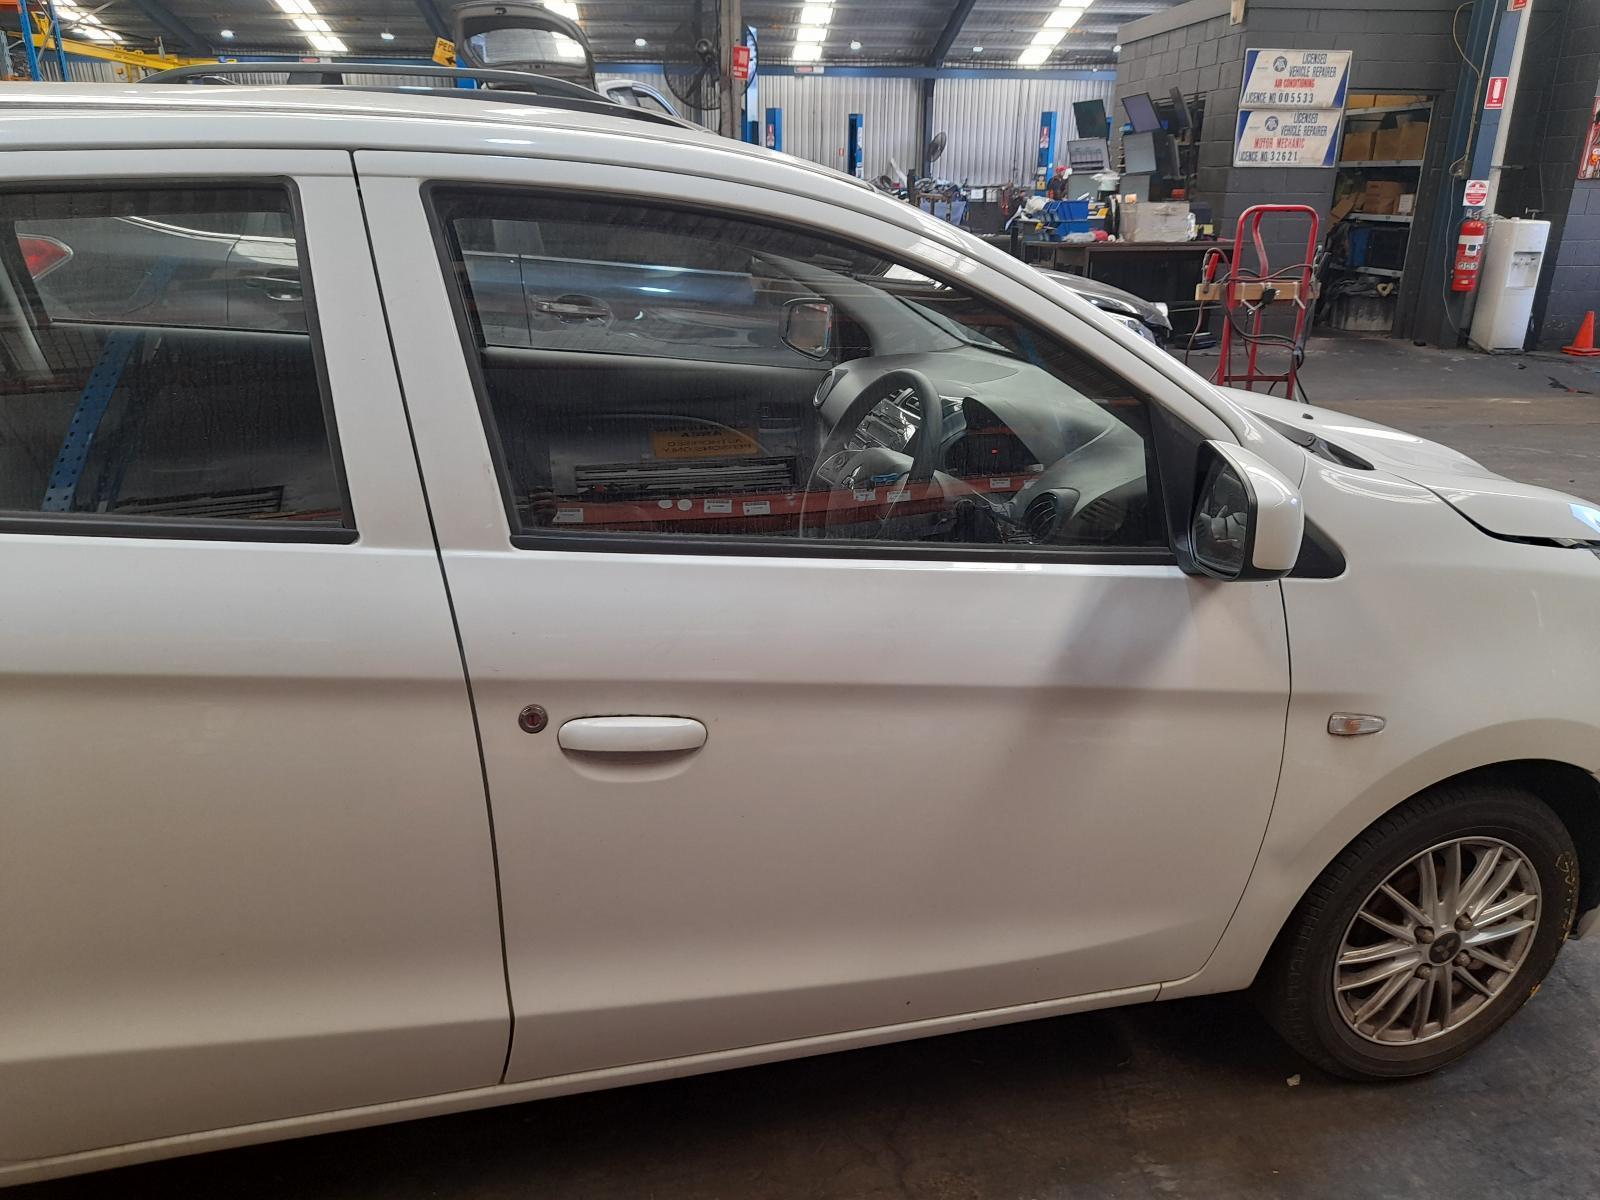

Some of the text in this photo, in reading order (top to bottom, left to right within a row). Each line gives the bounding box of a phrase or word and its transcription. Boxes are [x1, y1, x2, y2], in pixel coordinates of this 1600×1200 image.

[1302, 53, 1328, 65] LICENSED
[1289, 66, 1337, 77] VEHICLE REPAIRER
[1274, 79, 1315, 88] AIR CONDITIONING
[1245, 92, 1266, 103] LICENCE
[1278, 92, 1314, 103] 005533
[1294, 112, 1318, 124] LICENSED
[1281, 125, 1328, 136] VEHICLE REPAIRER
[1254, 137, 1305, 148] MOTOR MECHANIC
[1239, 151, 1258, 161] LICENCE
[1270, 151, 1298, 161] 32621
